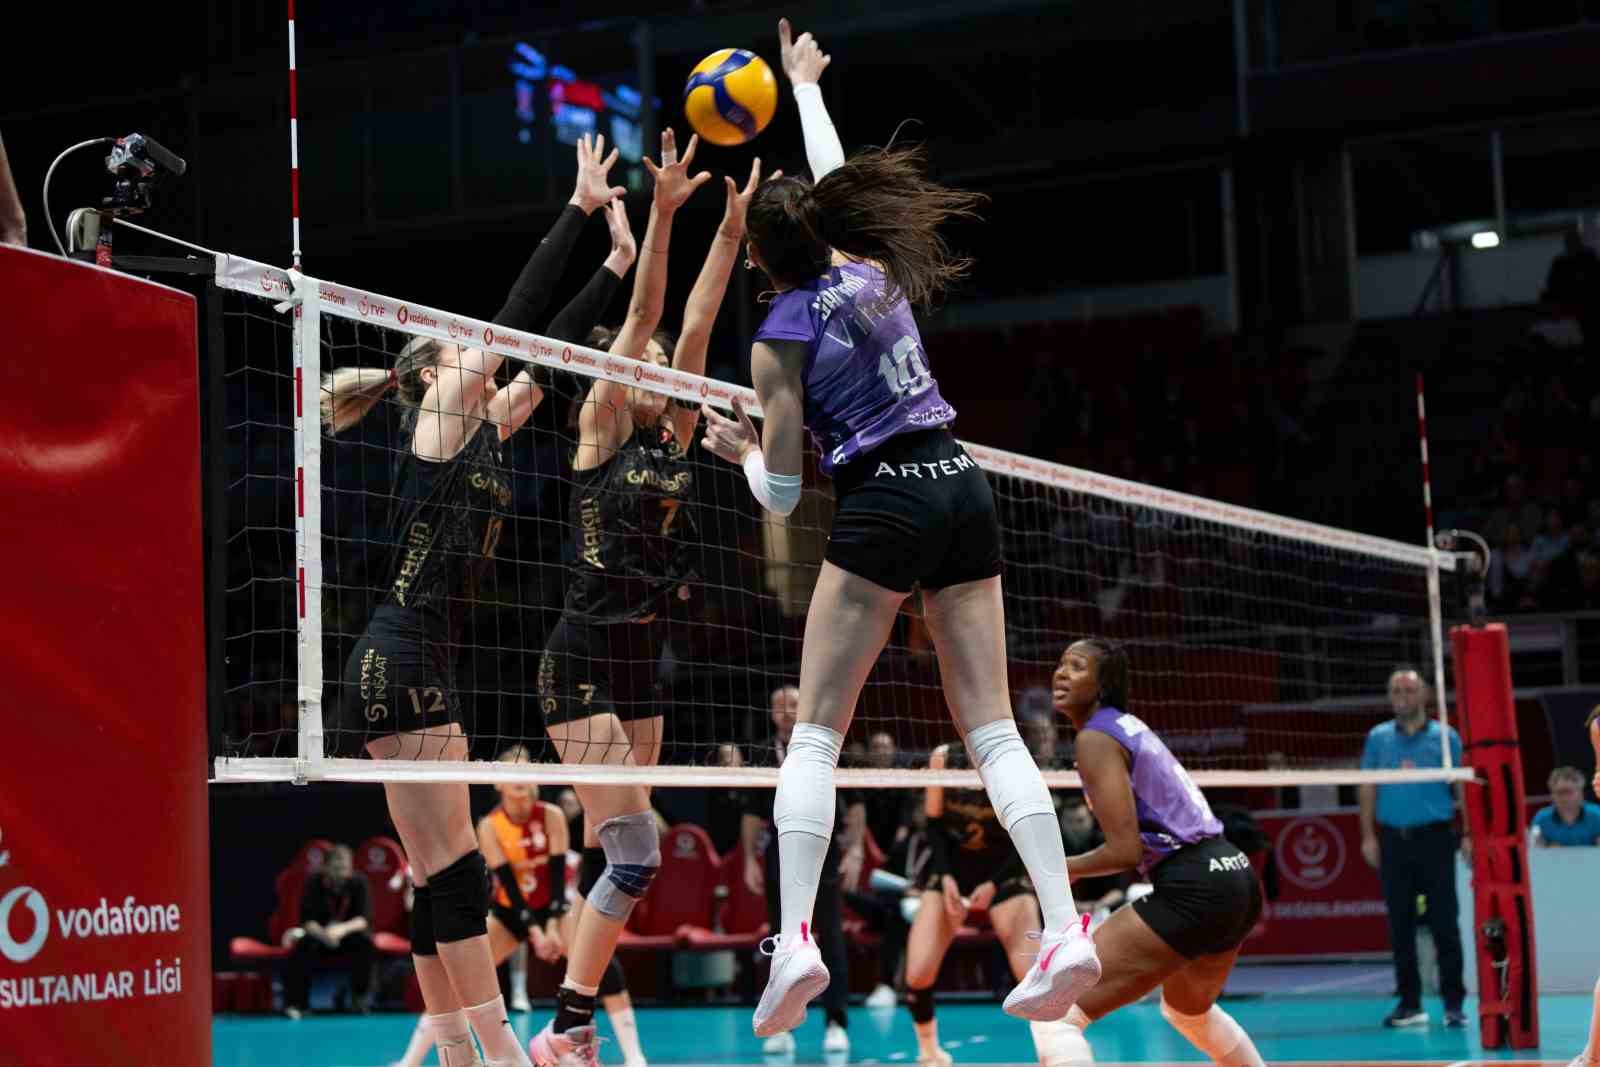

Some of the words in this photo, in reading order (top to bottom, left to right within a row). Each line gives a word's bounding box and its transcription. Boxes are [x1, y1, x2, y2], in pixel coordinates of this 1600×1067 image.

[369, 303, 386, 316] TVF
[409, 312, 438, 328] vodafone
[459, 326, 473, 337] TVF
[493, 335, 520, 348] vodafone
[878, 335, 932, 397] 10
[658, 499, 678, 536] 7
[408, 686, 446, 715] 12
[577, 683, 595, 705] 7
[57, 896, 181, 939] vodafone
[0, 970, 134, 1009] SULTANLAR
